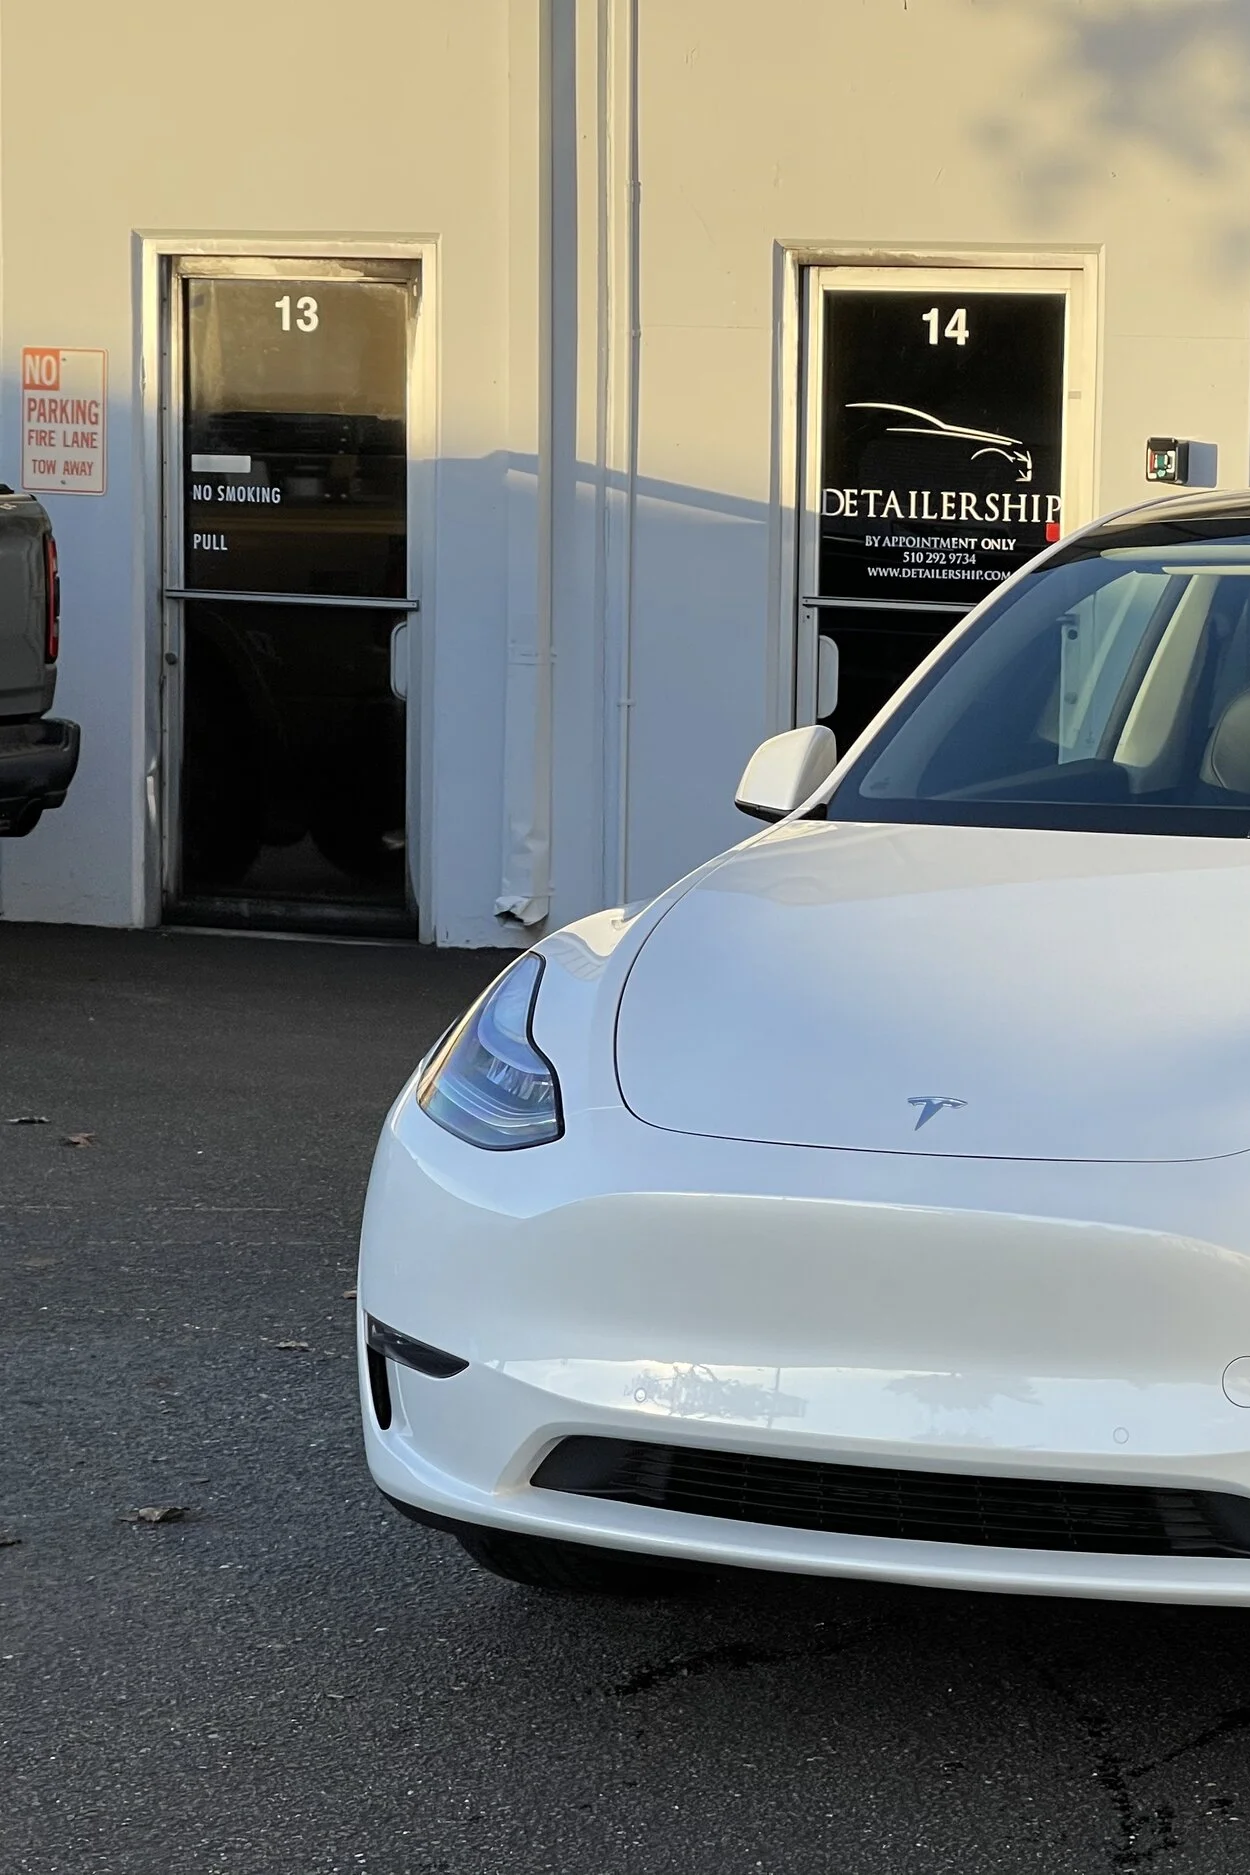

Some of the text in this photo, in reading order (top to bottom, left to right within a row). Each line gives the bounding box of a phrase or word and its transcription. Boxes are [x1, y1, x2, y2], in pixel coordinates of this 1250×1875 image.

[275, 295, 319, 332] 13
[922, 308, 969, 345] 14
[25, 354, 58, 386] NO
[27, 398, 99, 425] PARKING
[28, 429, 98, 449] FIRE LANE
[32, 459, 94, 476] TOW AWAY
[193, 484, 281, 504] NO SMOKING
[822, 487, 1062, 523] DETAILERSHIP
[193, 533, 228, 551] PULL
[865, 535, 1016, 551] BY APPOINTMENT ONLY
[903, 551, 976, 565] 510 292 9734
[867, 566, 1011, 581] WWW.DETAILERSHIP.COM
